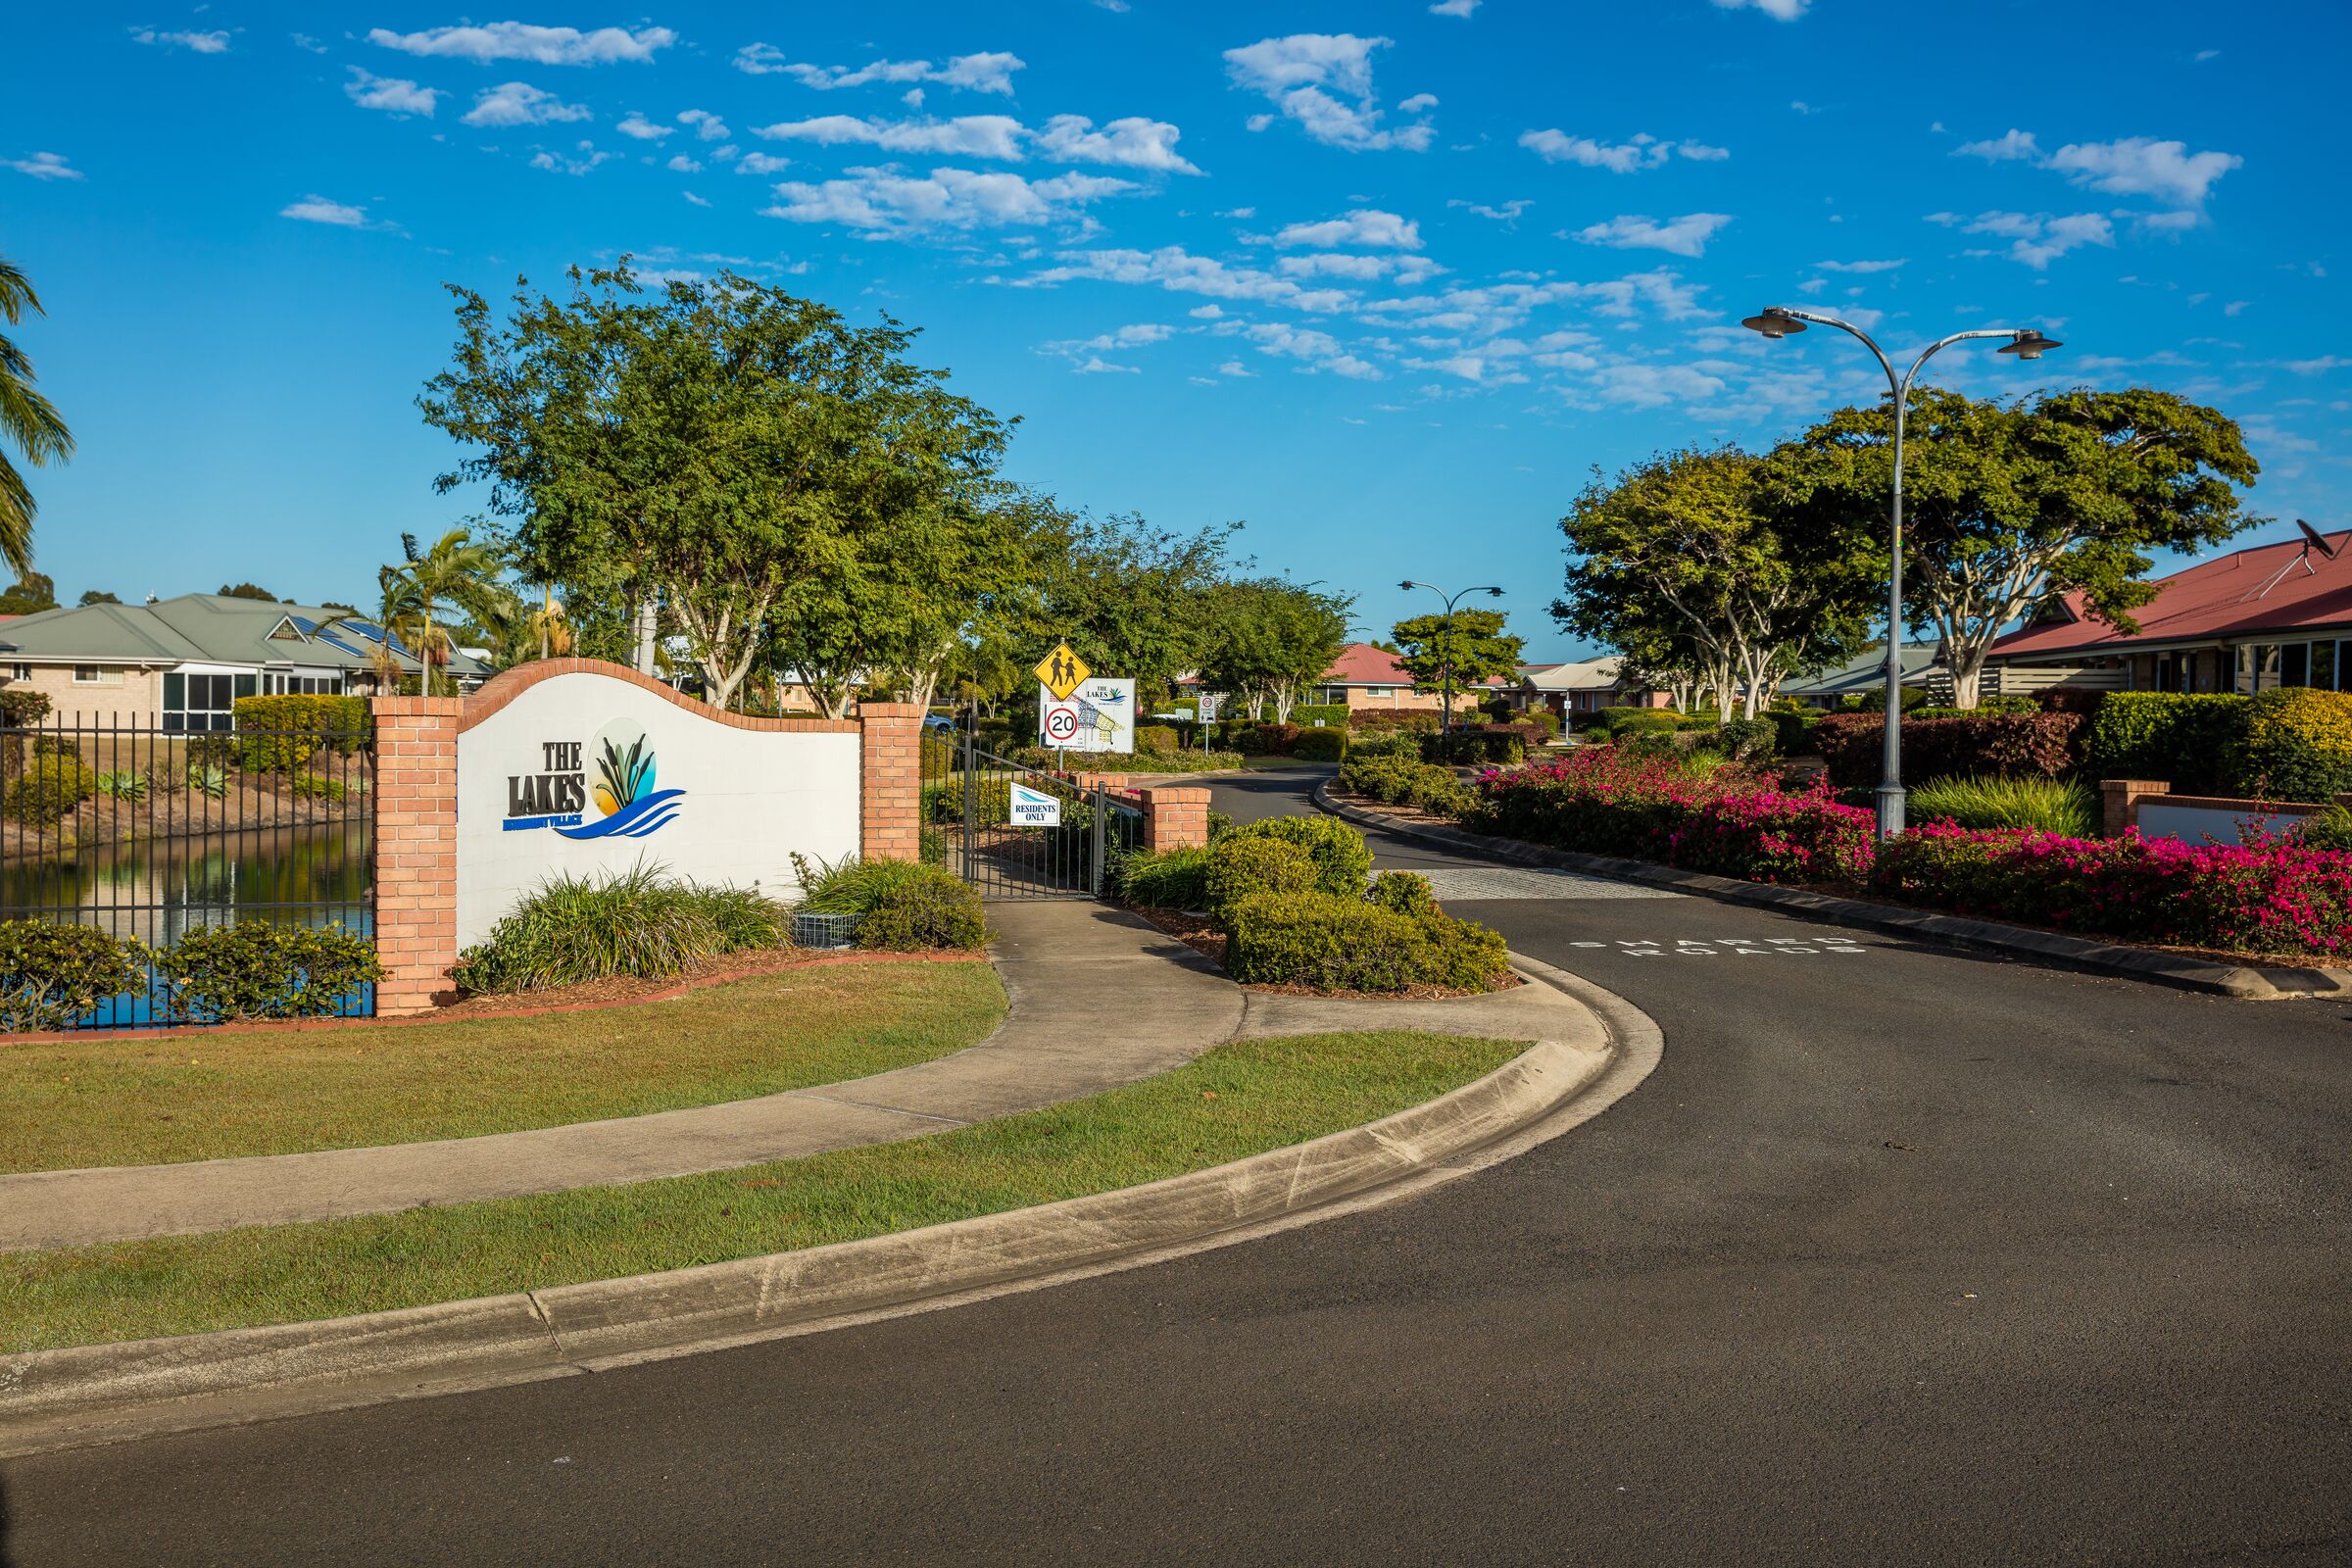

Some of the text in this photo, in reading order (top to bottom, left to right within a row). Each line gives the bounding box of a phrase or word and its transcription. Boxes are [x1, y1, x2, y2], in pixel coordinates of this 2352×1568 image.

[1052, 715, 1074, 731] 20
[543, 742, 582, 771] THE
[508, 773, 586, 817] LAKES
[1015, 805, 1056, 813] RESIDENTS
[1621, 947, 1867, 956] ROADS
